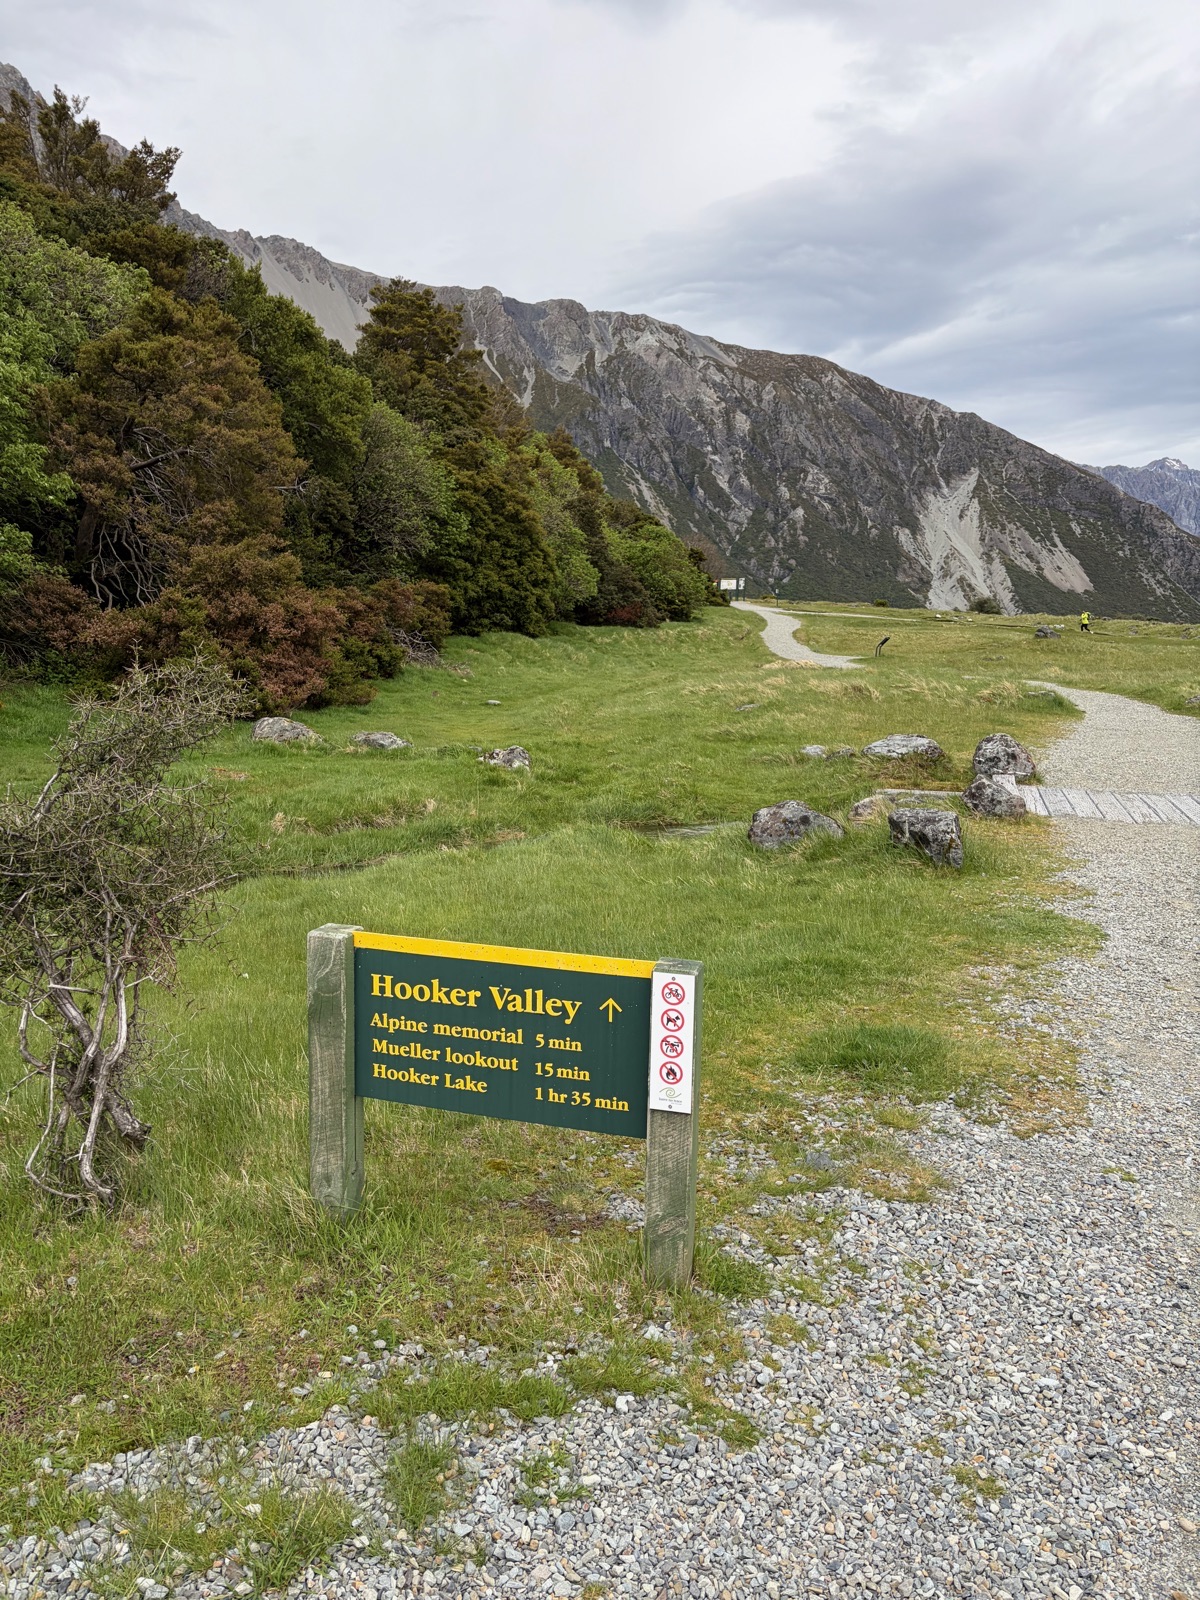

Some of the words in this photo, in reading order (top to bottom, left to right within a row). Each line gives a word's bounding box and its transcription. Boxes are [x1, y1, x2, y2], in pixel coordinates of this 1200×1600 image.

[371, 974, 481, 1007] Hooker
[489, 986, 581, 1024] Valley
[370, 1013, 427, 1033] Alpine
[433, 1024, 523, 1044] memorial
[535, 1034, 545, 1048] 5
[548, 1037, 582, 1052] min
[372, 1039, 440, 1060] Mueller
[446, 1047, 518, 1071] lookout
[535, 1062, 554, 1077] 15
[556, 1066, 590, 1081] min
[372, 1064, 439, 1085] Hooker
[444, 1074, 487, 1092] Lake
[535, 1087, 543, 1100] 1
[548, 1088, 567, 1103] hr
[570, 1091, 591, 1106] 35
[594, 1096, 629, 1112] min
